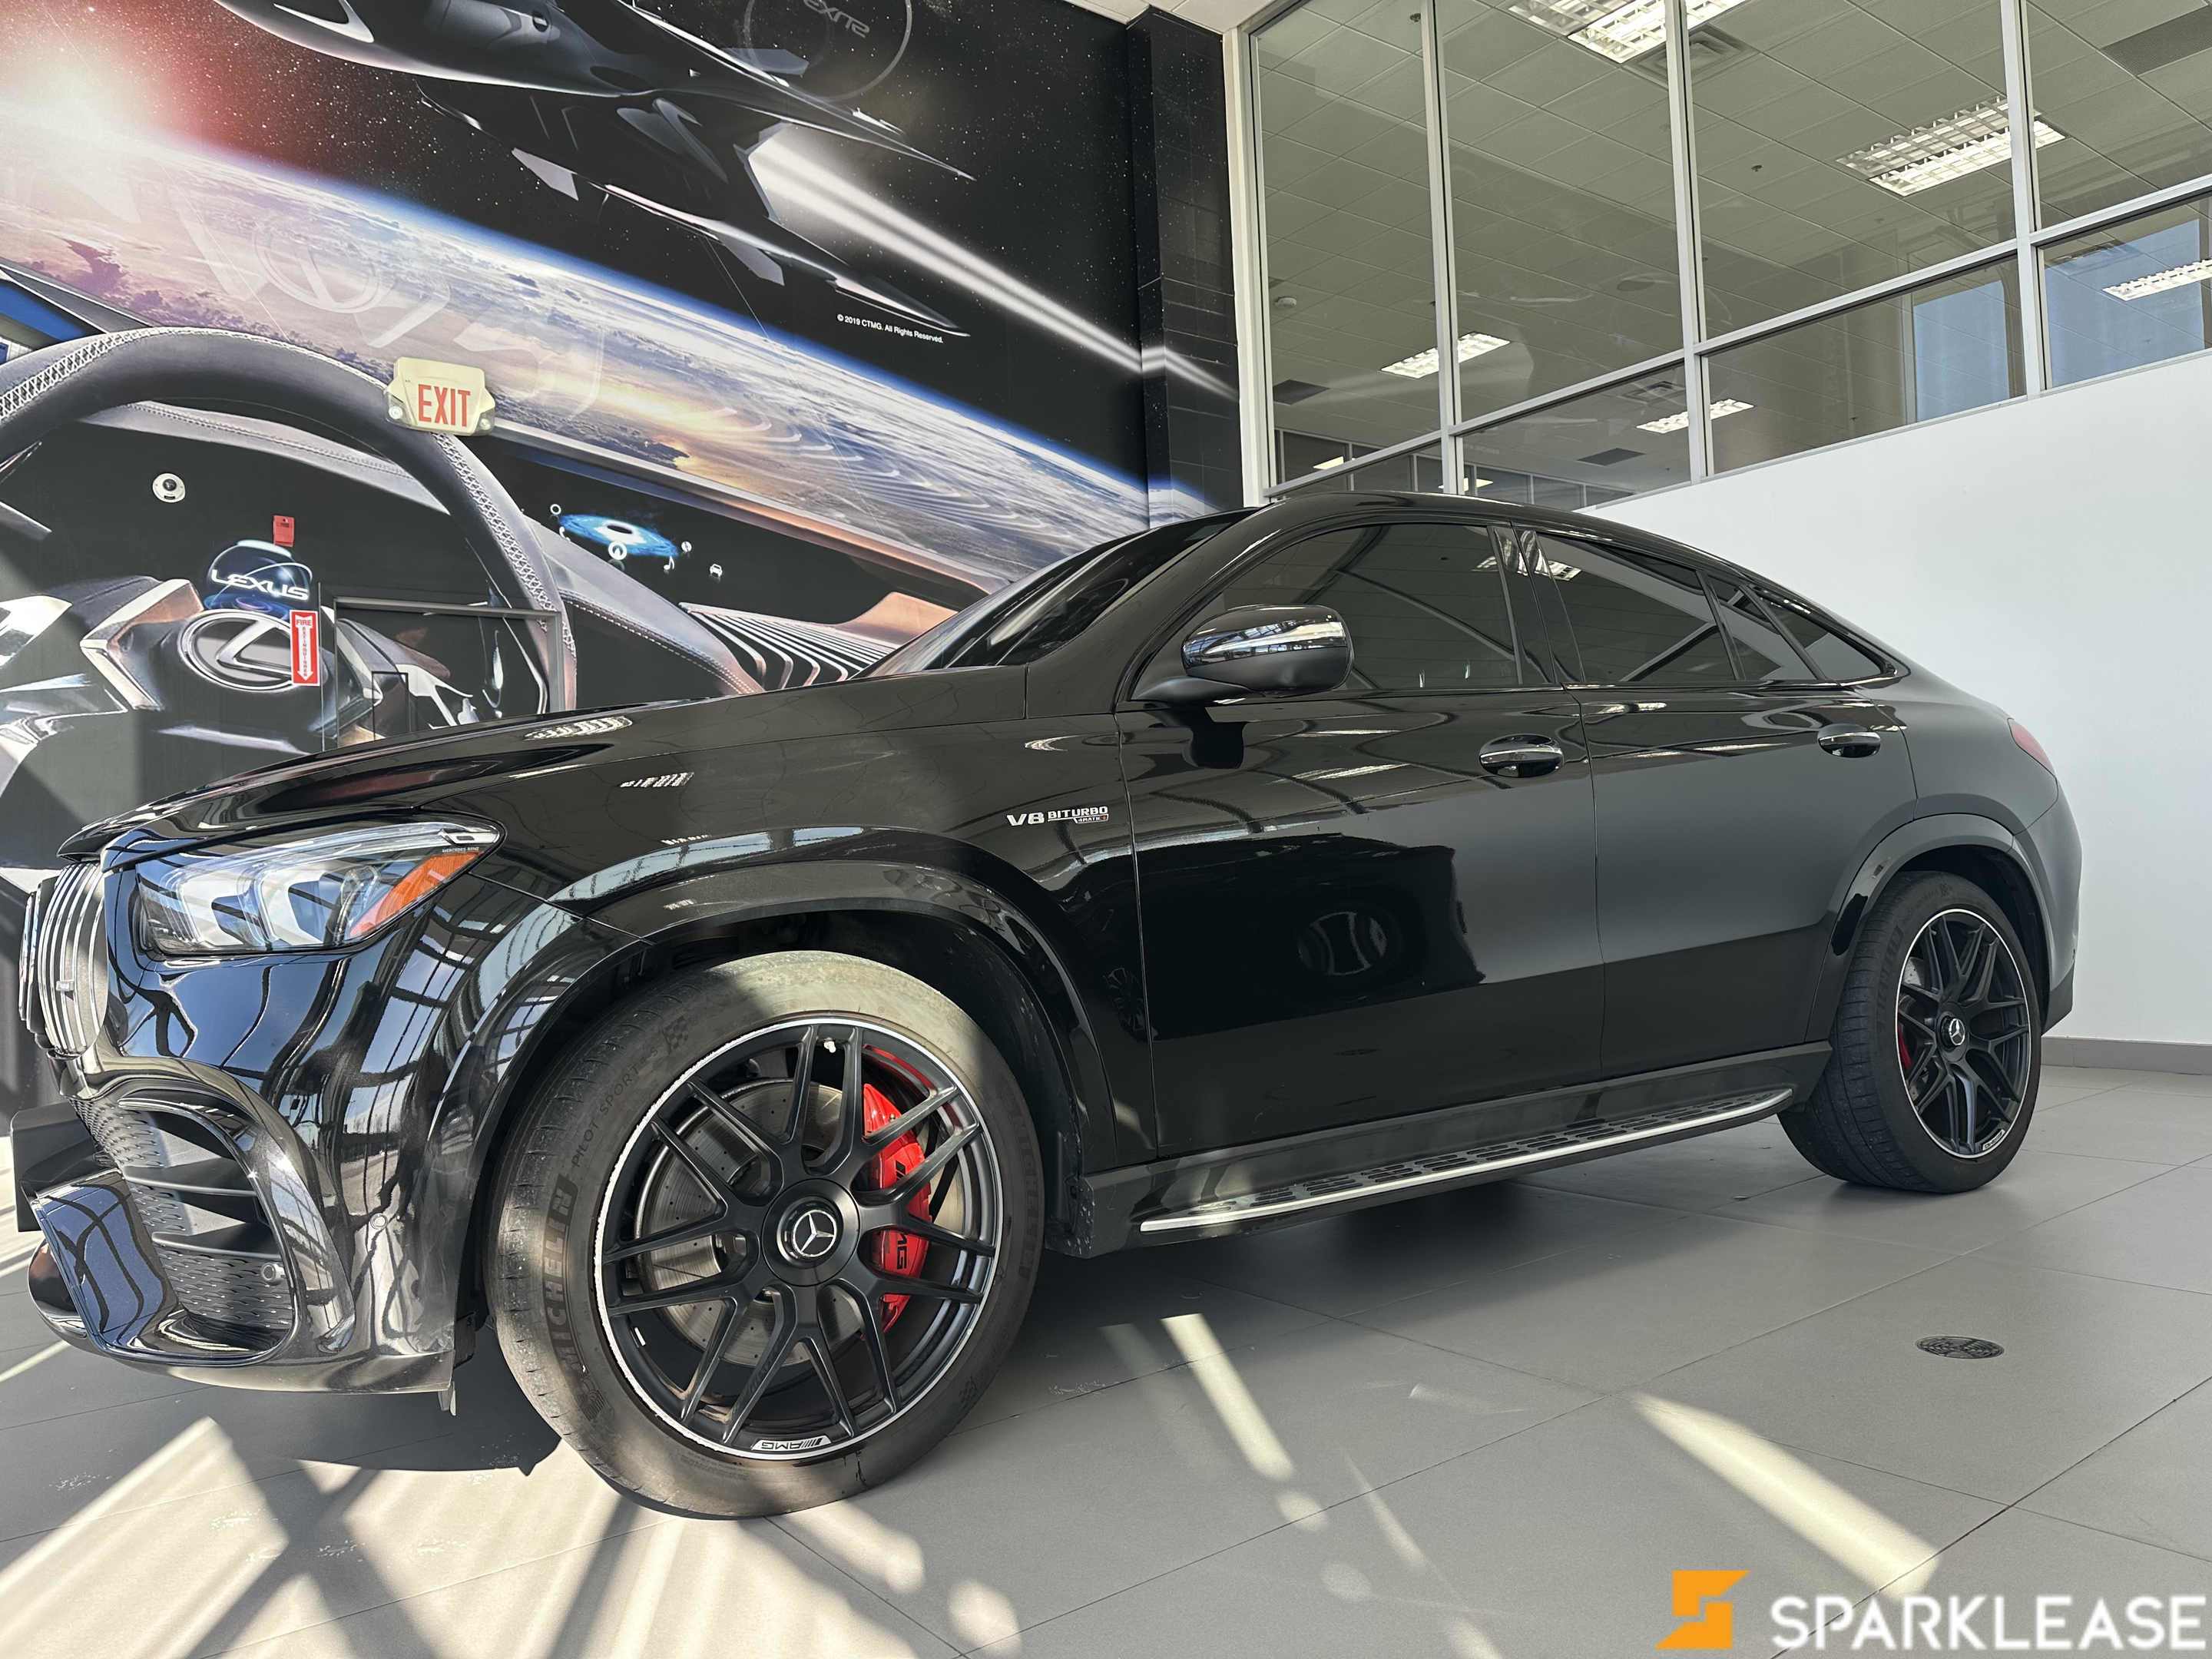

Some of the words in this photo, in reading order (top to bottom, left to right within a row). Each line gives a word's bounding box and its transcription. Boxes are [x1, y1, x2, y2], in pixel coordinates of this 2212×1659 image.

[845, 316, 861, 326] 2019
[861, 320, 883, 330] CTMG.
[884, 324, 893, 333] All
[894, 326, 913, 336] Rights
[914, 330, 944, 343] Reserved.
[418, 383, 471, 427] EXIT
[211, 569, 310, 601] LEXUS
[1007, 812, 1045, 826] V8
[1048, 806, 1108, 820] BITURBO
[571, 1121, 599, 1167] PILOT
[600, 1065, 640, 1115] SPORT
[544, 1189, 578, 1369] MICHELIN
[761, 1442, 802, 1450] AMG
